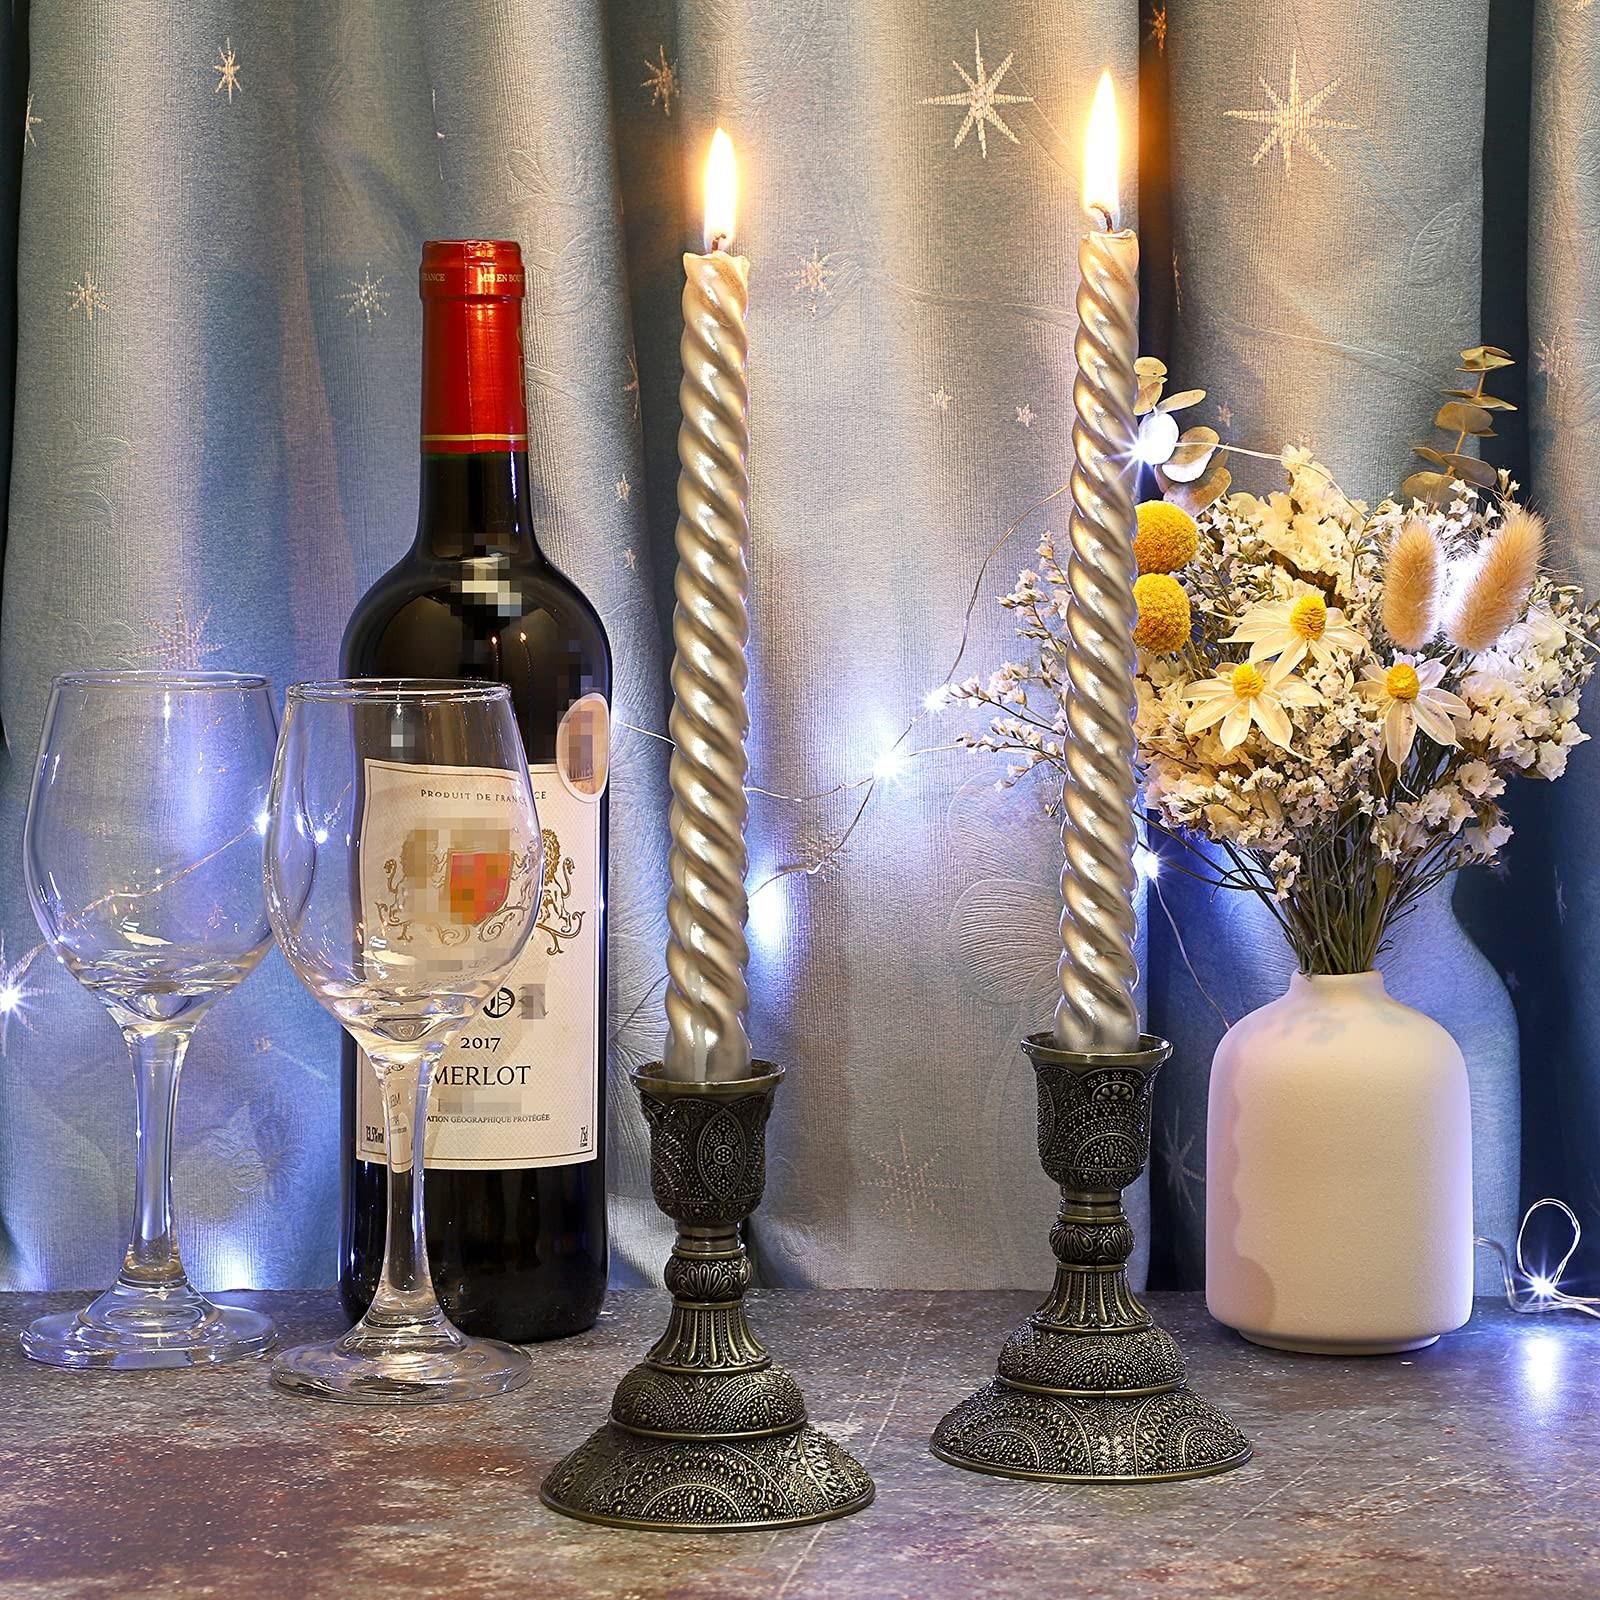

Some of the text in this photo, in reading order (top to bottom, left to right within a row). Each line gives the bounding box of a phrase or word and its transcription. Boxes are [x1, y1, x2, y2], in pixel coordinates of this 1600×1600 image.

[496, 273, 508, 283] EN
[420, 788, 471, 801] PRODUIT
[476, 793, 491, 801] DE
[460, 1037, 501, 1053] 2017
[434, 1065, 532, 1086] MERLOT
[450, 1114, 512, 1124] GÉOGRAPHIQUE
[512, 1113, 551, 1123] PROTÉGÉE
